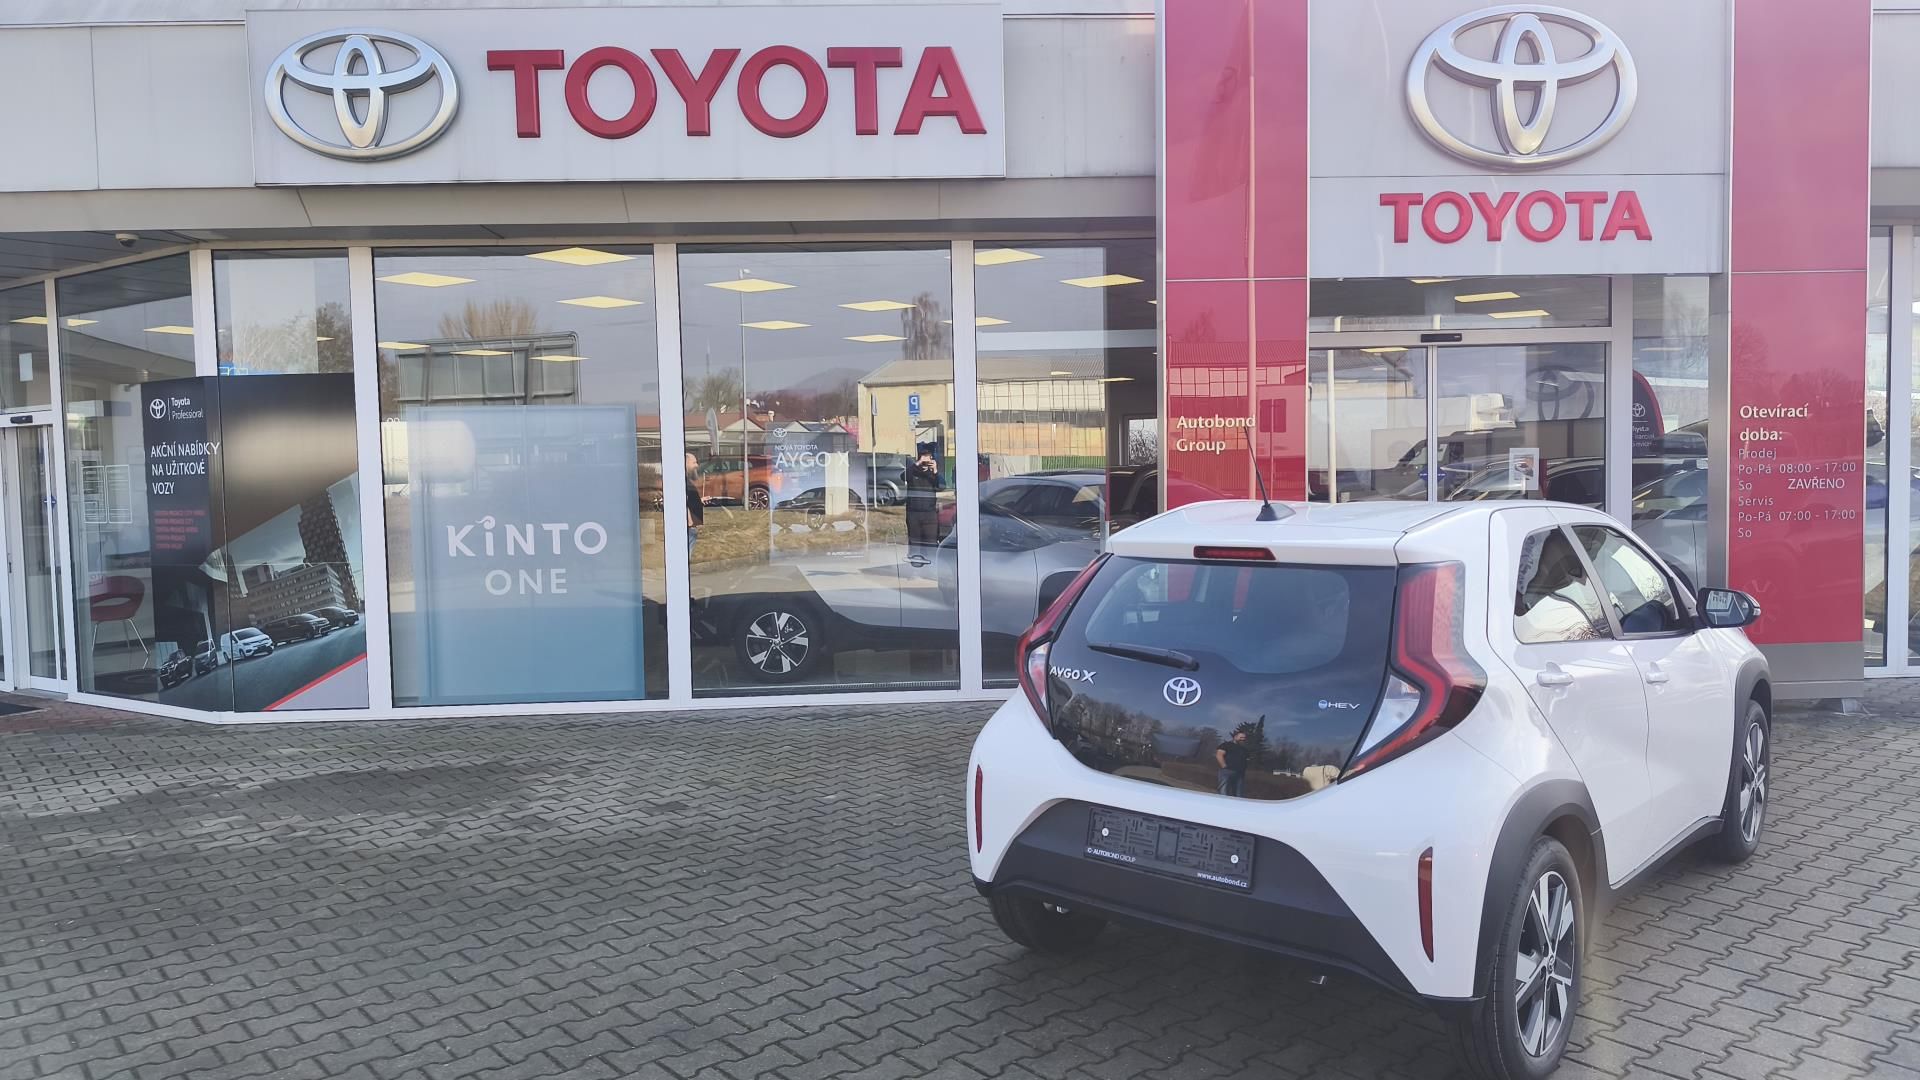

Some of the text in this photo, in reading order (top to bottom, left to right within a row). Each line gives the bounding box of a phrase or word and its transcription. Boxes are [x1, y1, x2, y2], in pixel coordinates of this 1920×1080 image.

[487, 45, 987, 139] TOYOTA
[1380, 190, 1652, 244] TOYOTA
[171, 397, 190, 408] Toyota
[171, 407, 203, 420] Professional
[1740, 403, 1809, 418] Otevírací
[1176, 413, 1256, 429] Autobond
[1740, 427, 1783, 441] doba:
[150, 439, 220, 458] AKČNÍ NABÍDKY
[1176, 438, 1226, 455] Group
[775, 451, 849, 469] AYGO X
[1738, 448, 1777, 460] Prodej
[152, 459, 206, 476] NA UŽITKOVÉ
[1738, 463, 1772, 474] Po-Pá
[1779, 463, 1812, 474] 08:00
[1825, 462, 1856, 473] 17:00
[152, 482, 175, 495] VOZY
[1738, 476, 1845, 490] So ZAVŘENO
[1738, 495, 1774, 506] Servis
[1738, 511, 1771, 522] Po-Pá
[1779, 511, 1811, 521] 07:00
[1824, 509, 1856, 520] 17:00
[1738, 528, 1752, 538] So
[485, 568, 568, 596] ONE
[1050, 666, 1097, 685] AYGO X
[1328, 702, 1360, 710] HEV
[1196, 872, 1248, 888] www.autobond.cz
